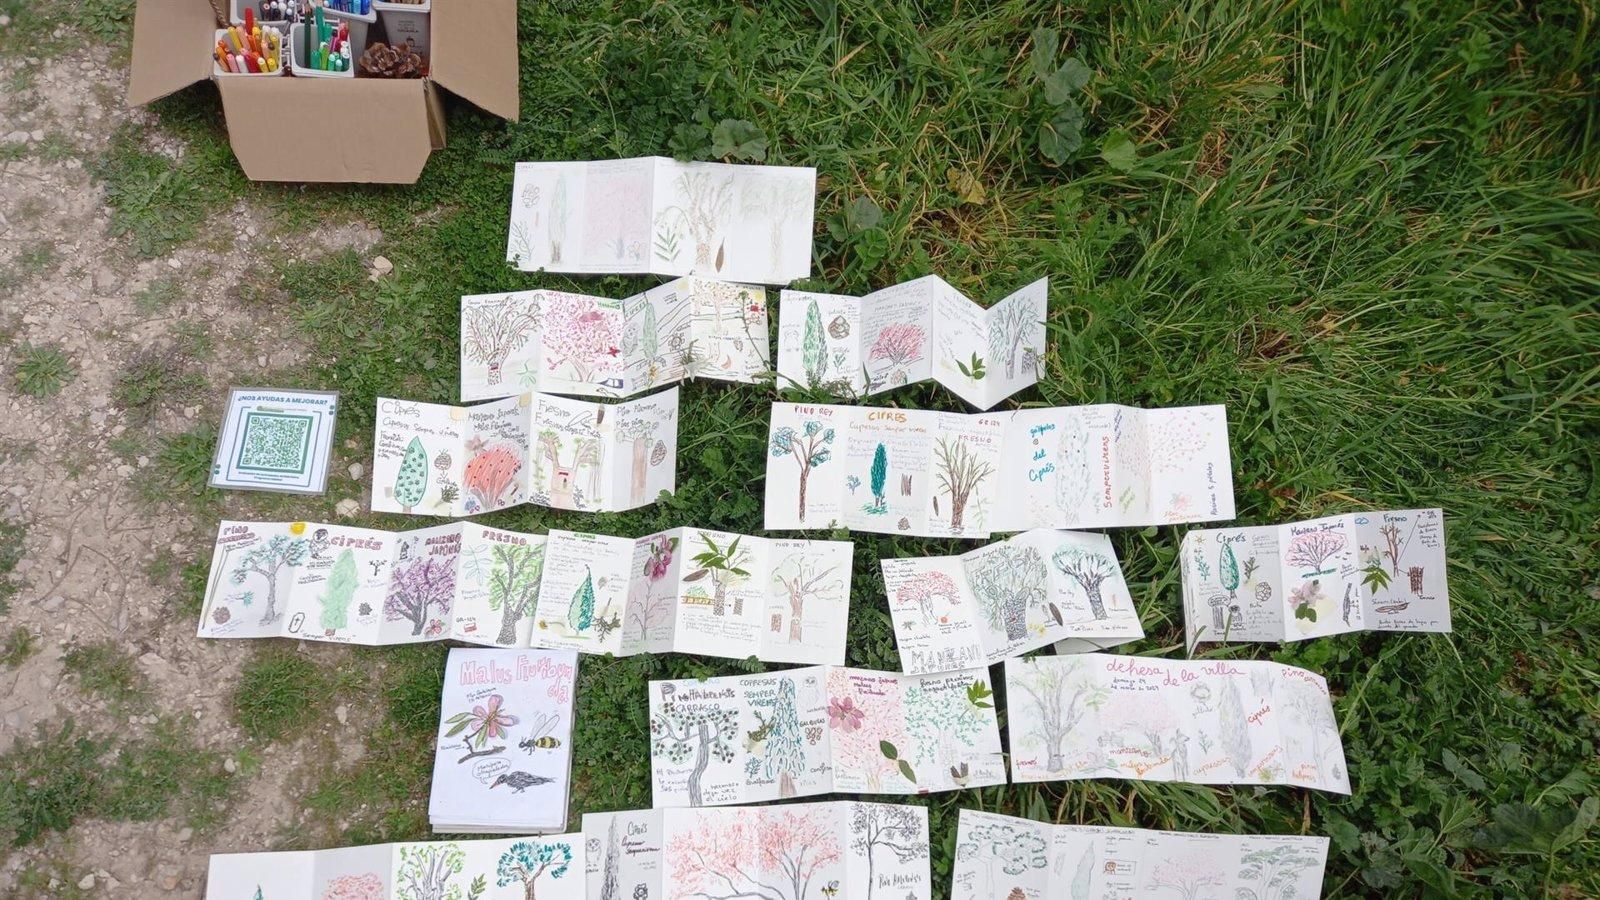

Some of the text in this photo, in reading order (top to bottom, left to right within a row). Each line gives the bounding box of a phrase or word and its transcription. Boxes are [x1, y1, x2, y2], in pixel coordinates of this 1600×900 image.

[292, 398, 329, 406] MEJORAR?
[795, 404, 815, 415] PINO
[868, 412, 908, 423] CIPRES
[1033, 448, 1047, 460] del
[1028, 462, 1056, 483] Ciprés
[1216, 532, 1246, 545] Ciprés
[460, 659, 513, 686] Malus
[1106, 658, 1248, 687] dehesa de la villa
[547, 679, 570, 705] da
